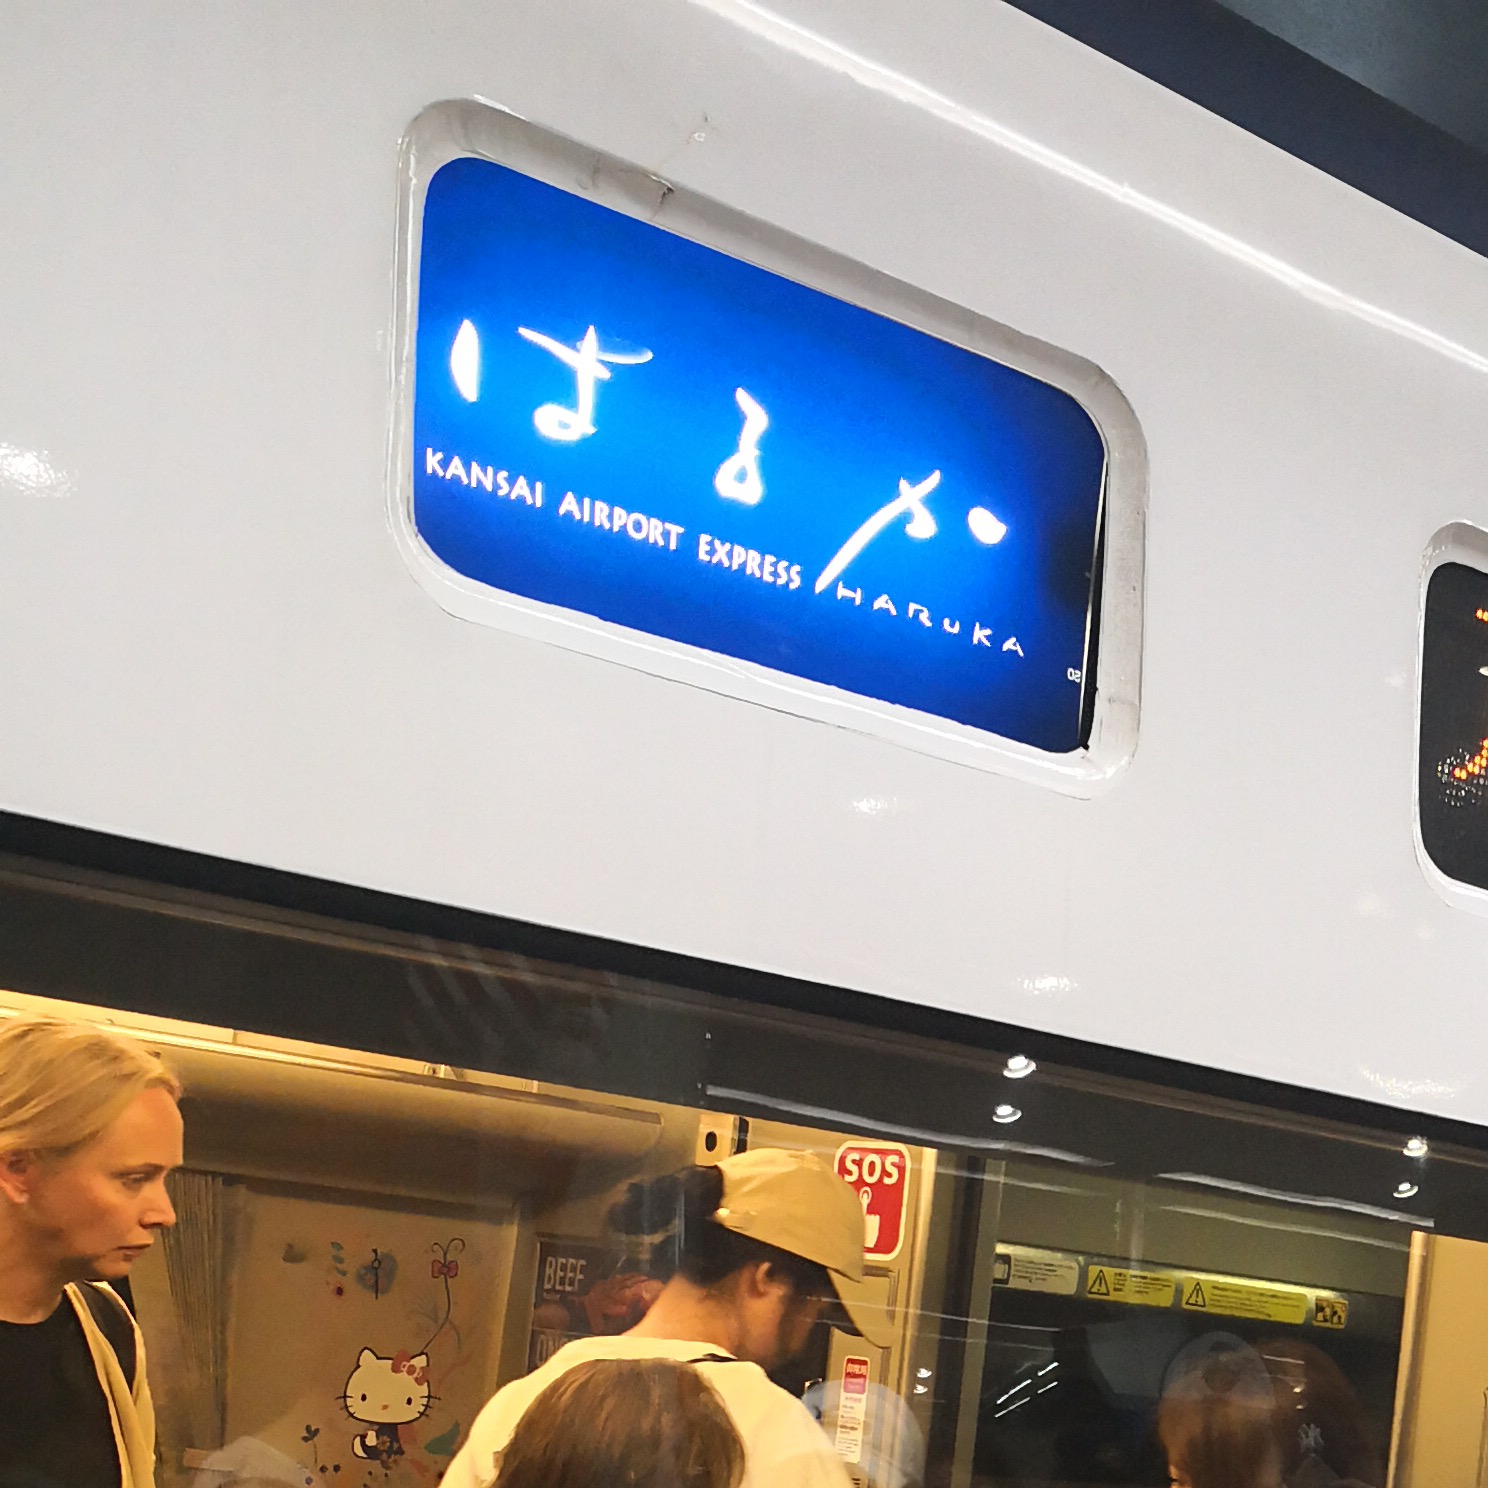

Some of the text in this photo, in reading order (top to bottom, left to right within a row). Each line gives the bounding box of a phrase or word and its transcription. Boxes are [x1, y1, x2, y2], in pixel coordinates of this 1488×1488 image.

[450, 318, 1007, 594] はるか
[426, 447, 802, 590] KANSAI AIRPORT EXPRESS
[843, 1152, 900, 1185] SOS
[543, 1255, 588, 1292] BEEF
